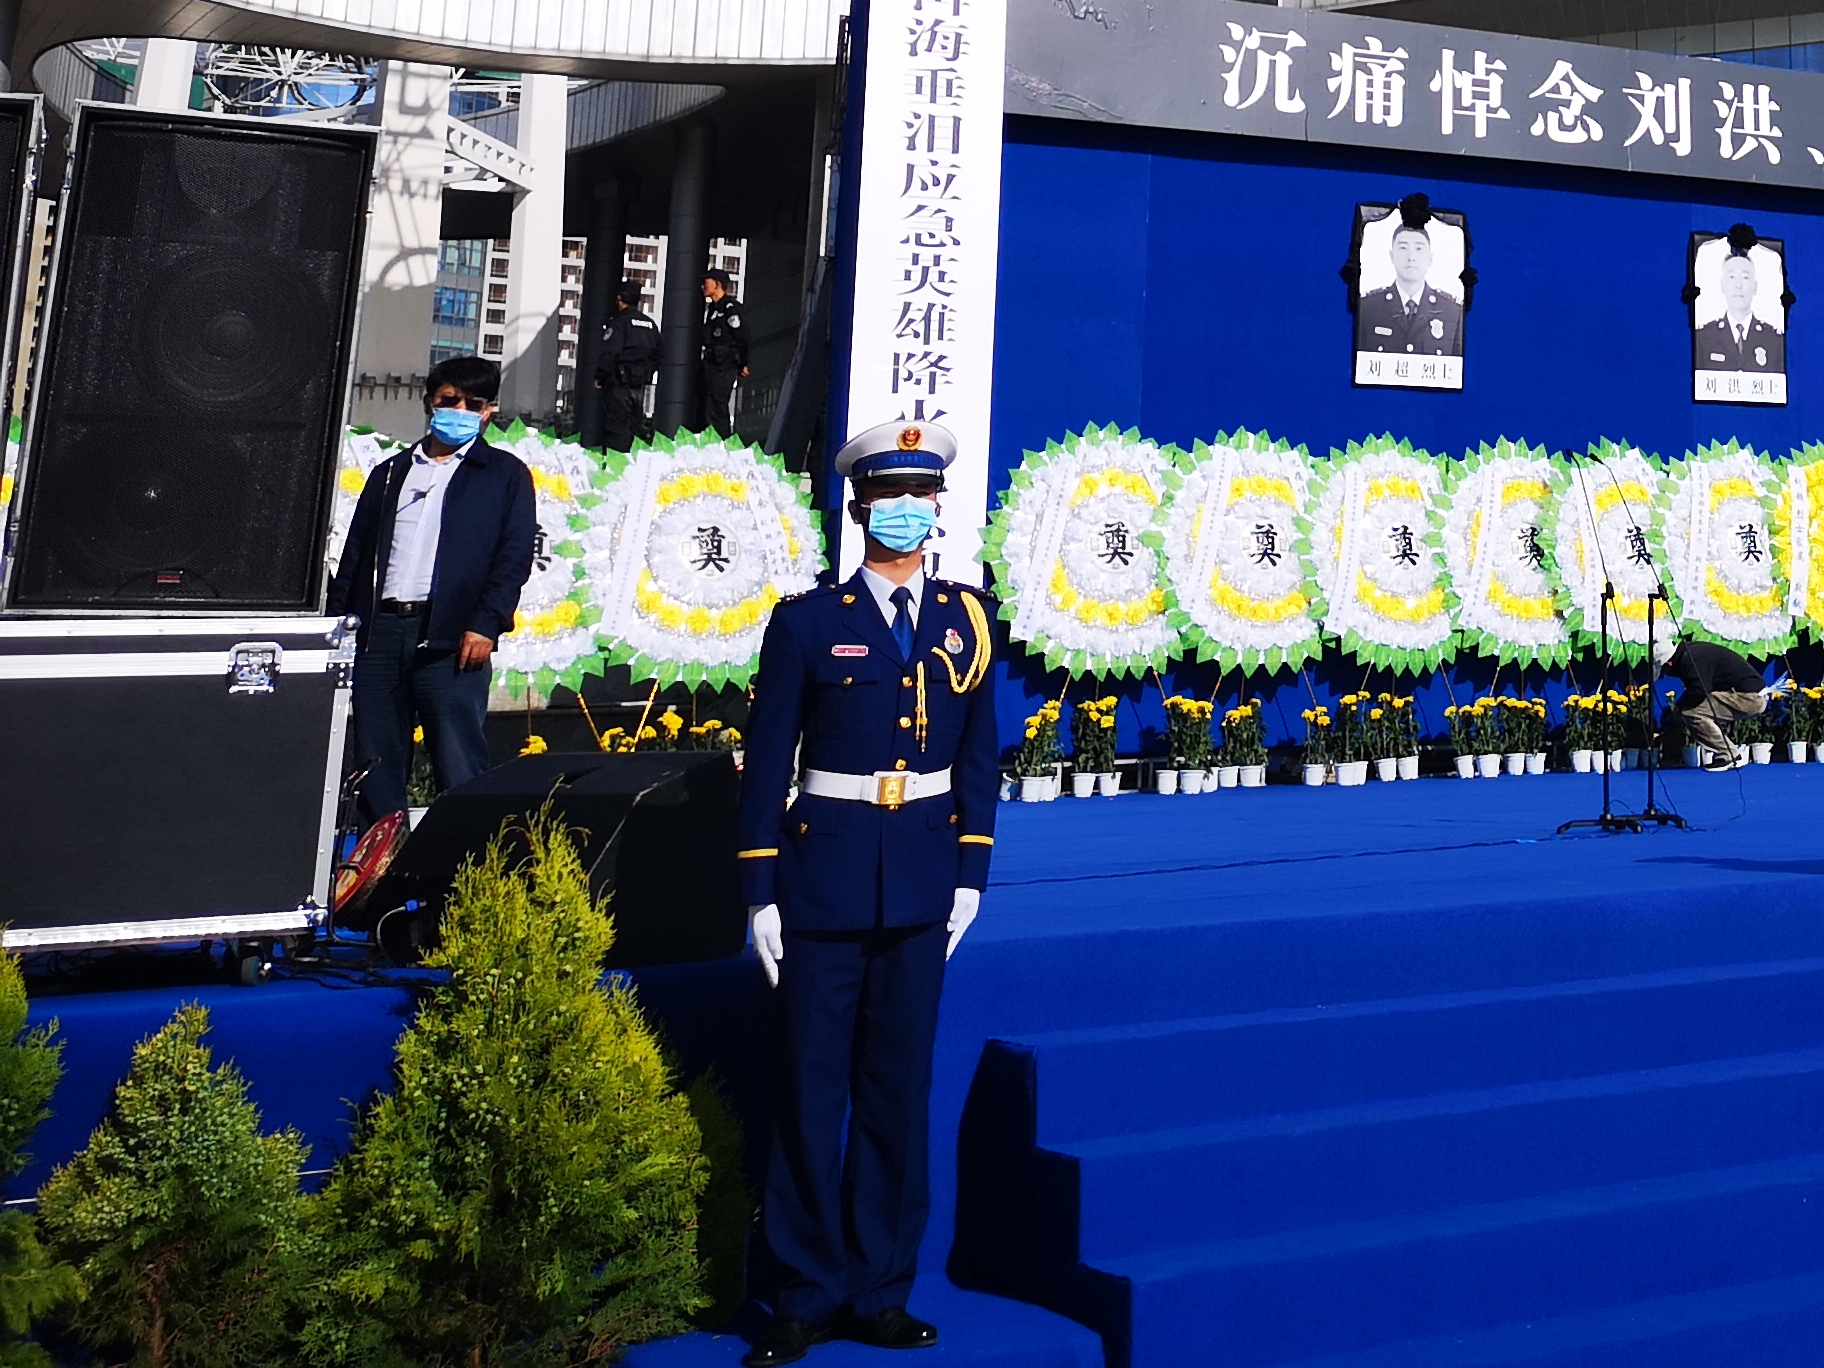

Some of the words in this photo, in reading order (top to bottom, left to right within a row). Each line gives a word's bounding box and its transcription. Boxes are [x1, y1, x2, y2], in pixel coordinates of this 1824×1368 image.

[690, 525, 730, 573] 奠
[1096, 520, 1134, 566] 奠
[1250, 523, 1282, 567] 奠
[1388, 524, 1420, 566] 奠
[1625, 525, 1652, 565] 奠
[1735, 523, 1763, 563] 奠
